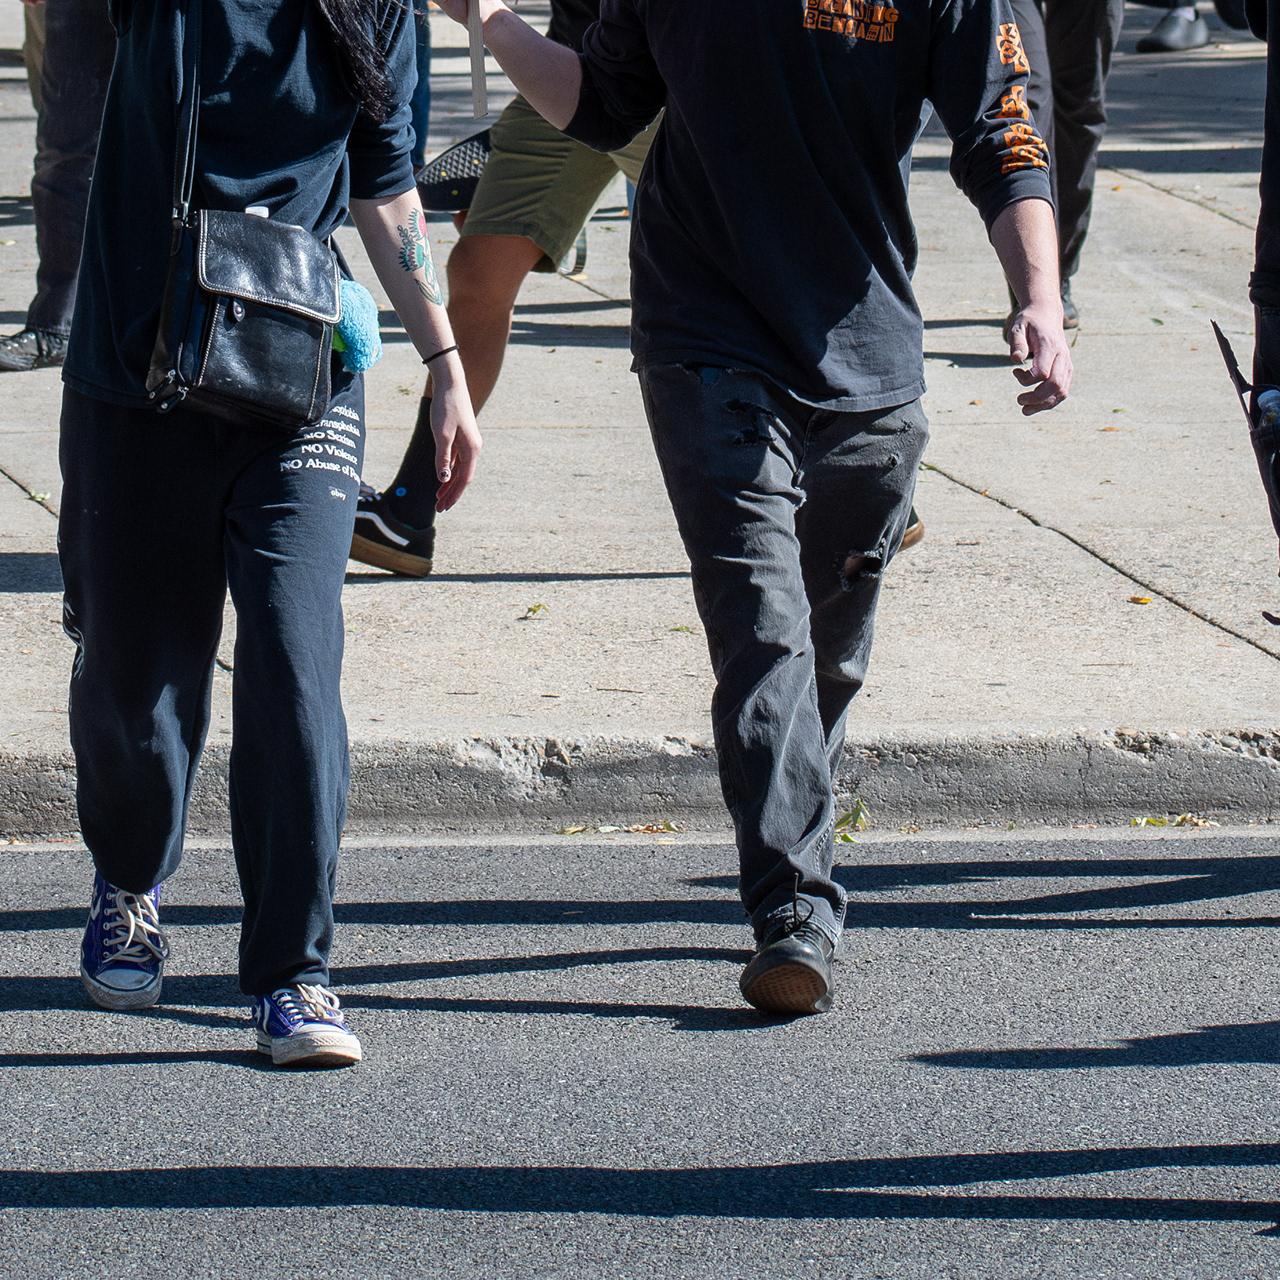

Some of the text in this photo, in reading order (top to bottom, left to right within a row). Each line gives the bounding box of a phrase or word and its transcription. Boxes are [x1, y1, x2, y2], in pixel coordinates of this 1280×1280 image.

[320, 419, 361, 437] ransphobia
[326, 429, 357, 449] Sexism
[301, 443, 323, 454] NO
[280, 459, 302, 472] NO
[305, 458, 341, 472] Abuse
[330, 488, 347, 501] obey
